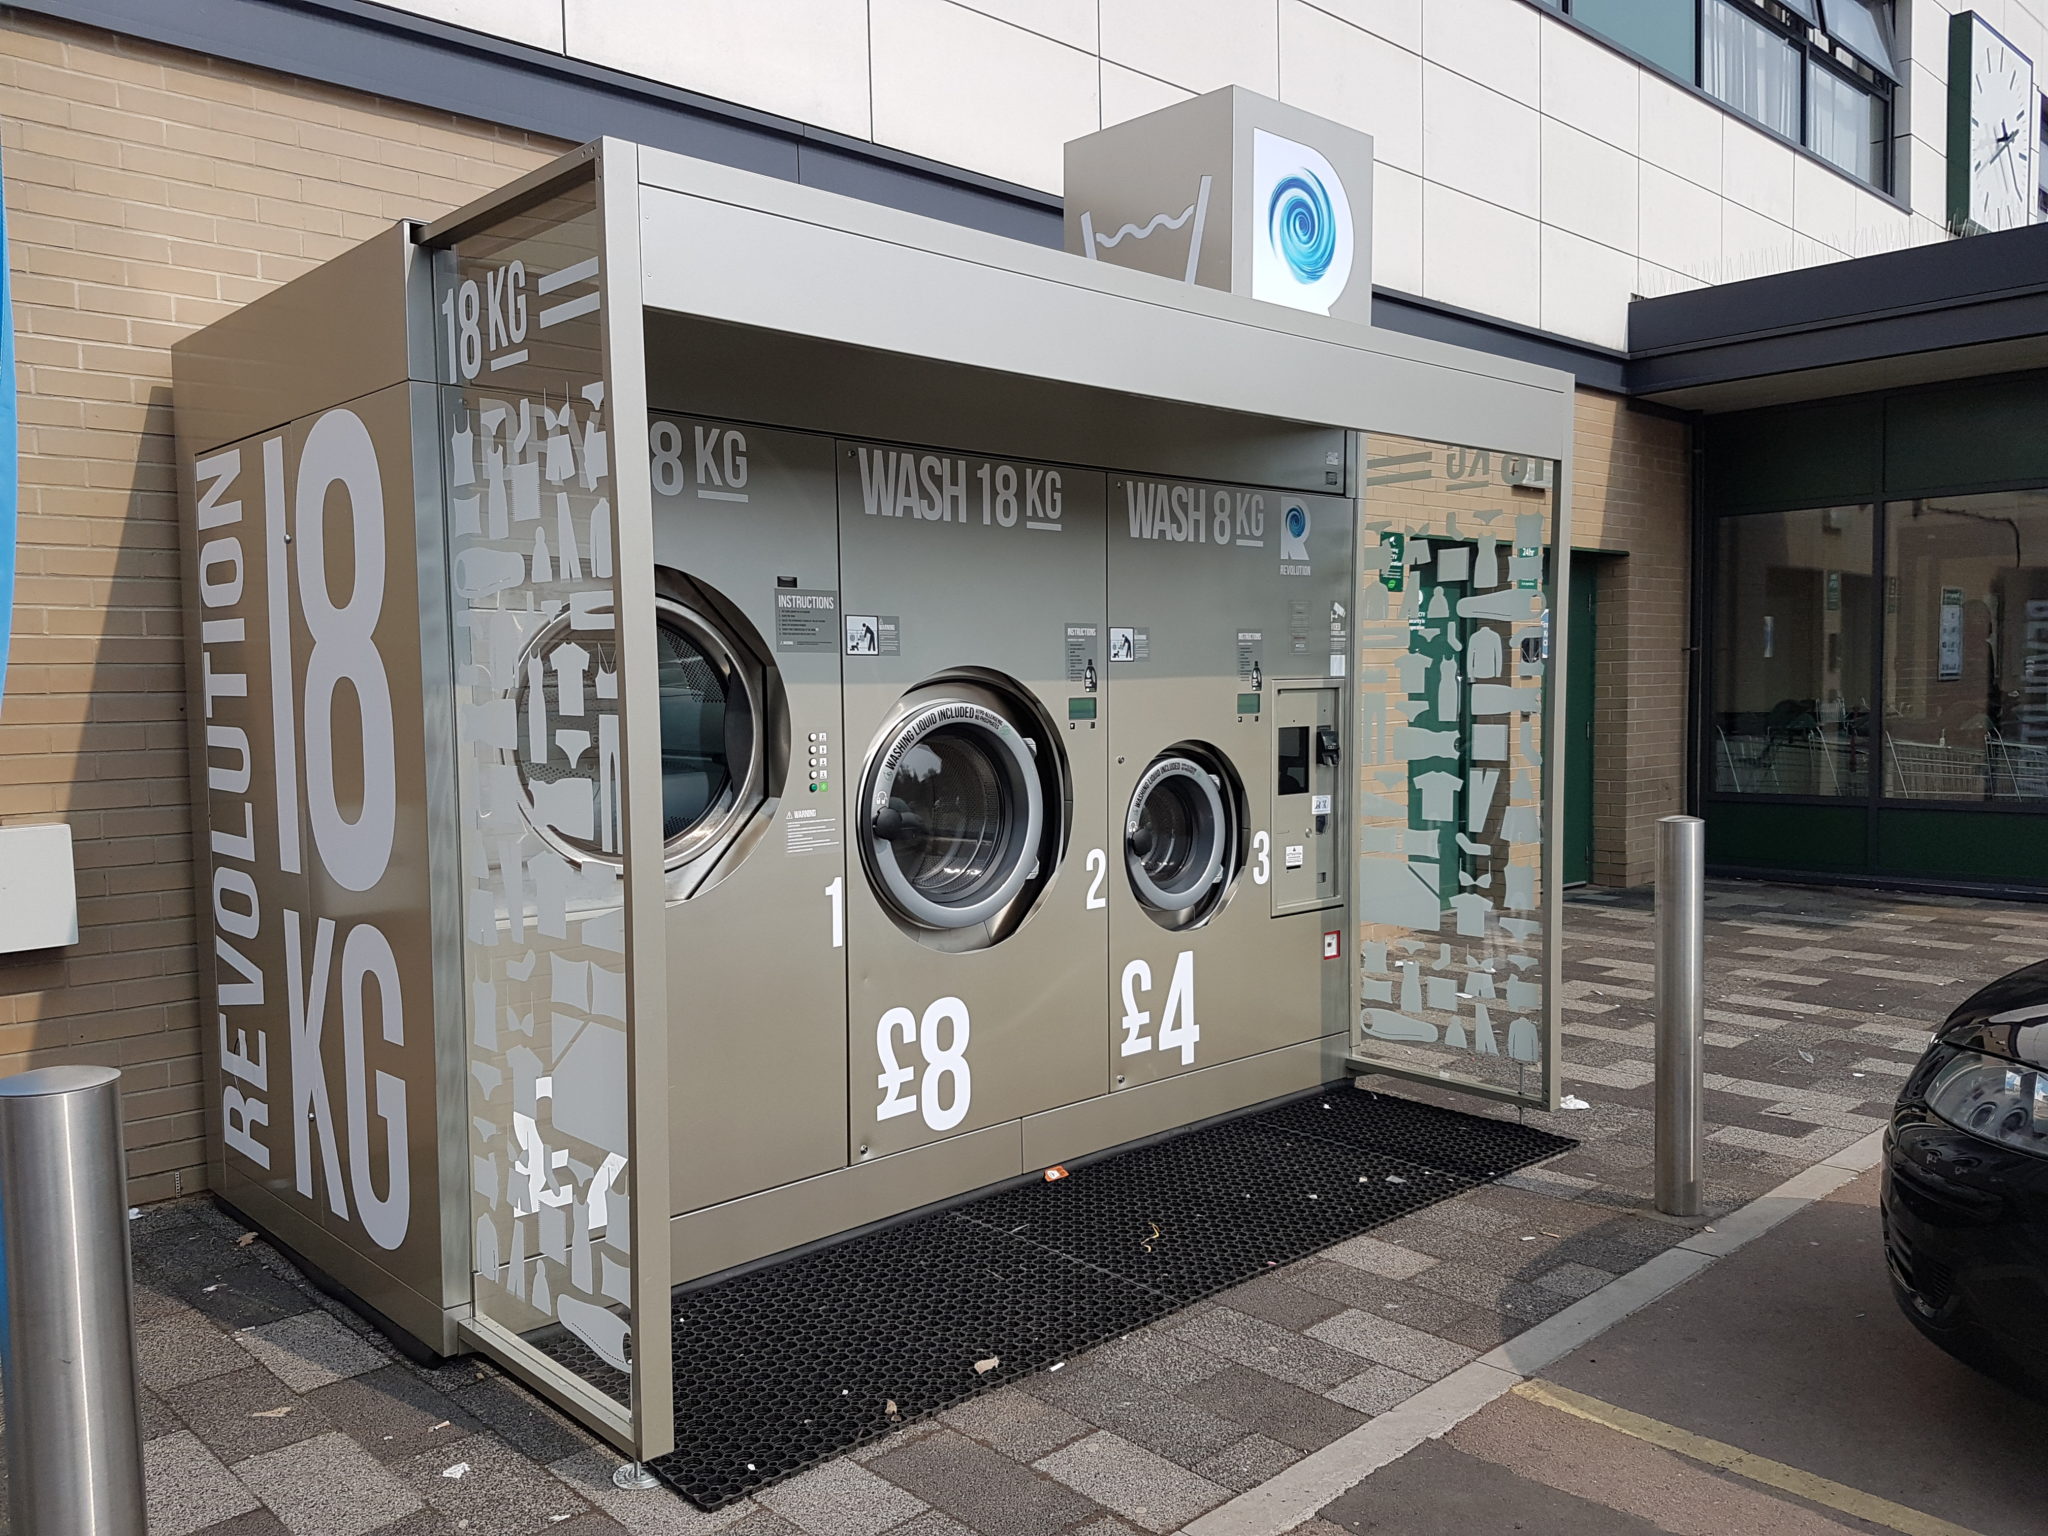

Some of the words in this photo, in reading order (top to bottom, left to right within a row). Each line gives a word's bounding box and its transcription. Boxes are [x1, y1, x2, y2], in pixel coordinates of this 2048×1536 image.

[441, 279, 482, 385] 18
[487, 259, 528, 352] KG
[650, 420, 684, 497] 8
[695, 426, 748, 488] KG
[858, 447, 967, 524] WASH
[976, 462, 1018, 528] 18
[1026, 467, 1063, 520] KG
[1126, 480, 1206, 544] WASH
[1213, 490, 1231, 545] 8
[1236, 492, 1264, 538] KG
[778, 594, 834, 609] INSTRUCTIONS
[1279, 564, 1311, 577] REVOLUTION
[263, 408, 397, 892] 18
[1067, 628, 1097, 636] INSTRUCTIONS
[885, 731, 915, 771] WASHING
[914, 712, 938, 736] LIQUID
[937, 706, 975, 722] INCLUDED
[196, 447, 271, 1171] REVOLUTION
[794, 809, 817, 818] WARNING
[1134, 781, 1150, 808] WASHING
[1148, 768, 1161, 785] LIQUID
[1160, 762, 1181, 774] INCLUDED
[1085, 848, 1107, 911] 2
[1252, 830, 1270, 885] 3
[825, 876, 844, 947] 1
[1121, 950, 1201, 1067] £4
[283, 908, 410, 1251] KG
[876, 996, 972, 1132] £8
